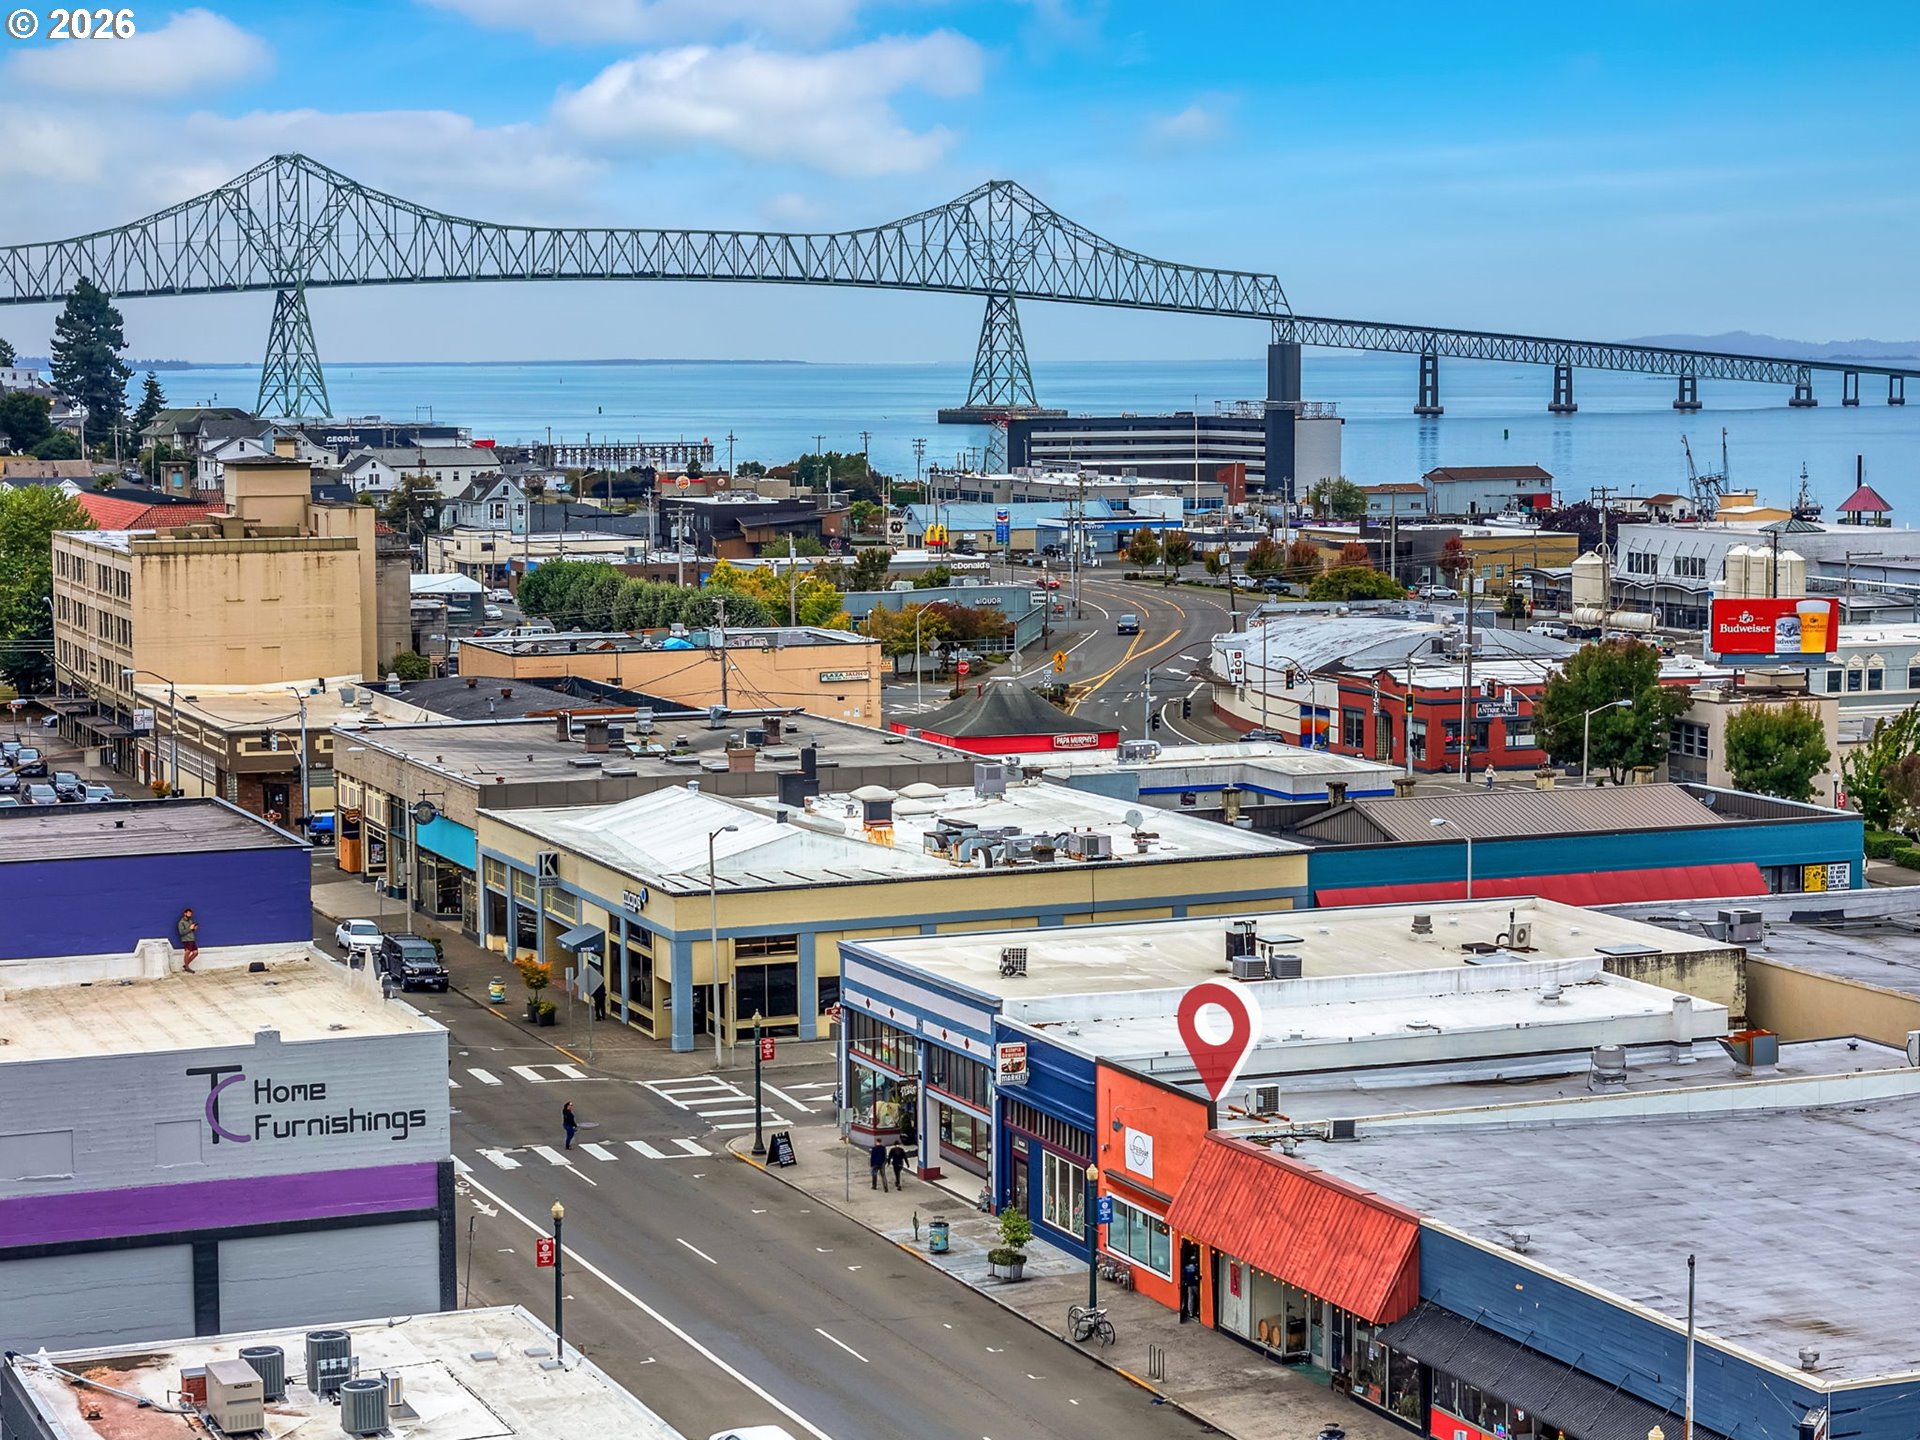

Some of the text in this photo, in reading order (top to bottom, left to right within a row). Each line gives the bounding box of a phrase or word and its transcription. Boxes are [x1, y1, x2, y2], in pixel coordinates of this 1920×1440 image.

[1719, 623, 1771, 634] Budweiser
[1234, 651, 1243, 683] BOWL
[1056, 735, 1097, 745] PAPA MURPHY'S
[540, 854, 559, 878] K
[623, 890, 642, 911] maps
[254, 1078, 326, 1104] Home
[254, 1108, 427, 1141] Furnishings
